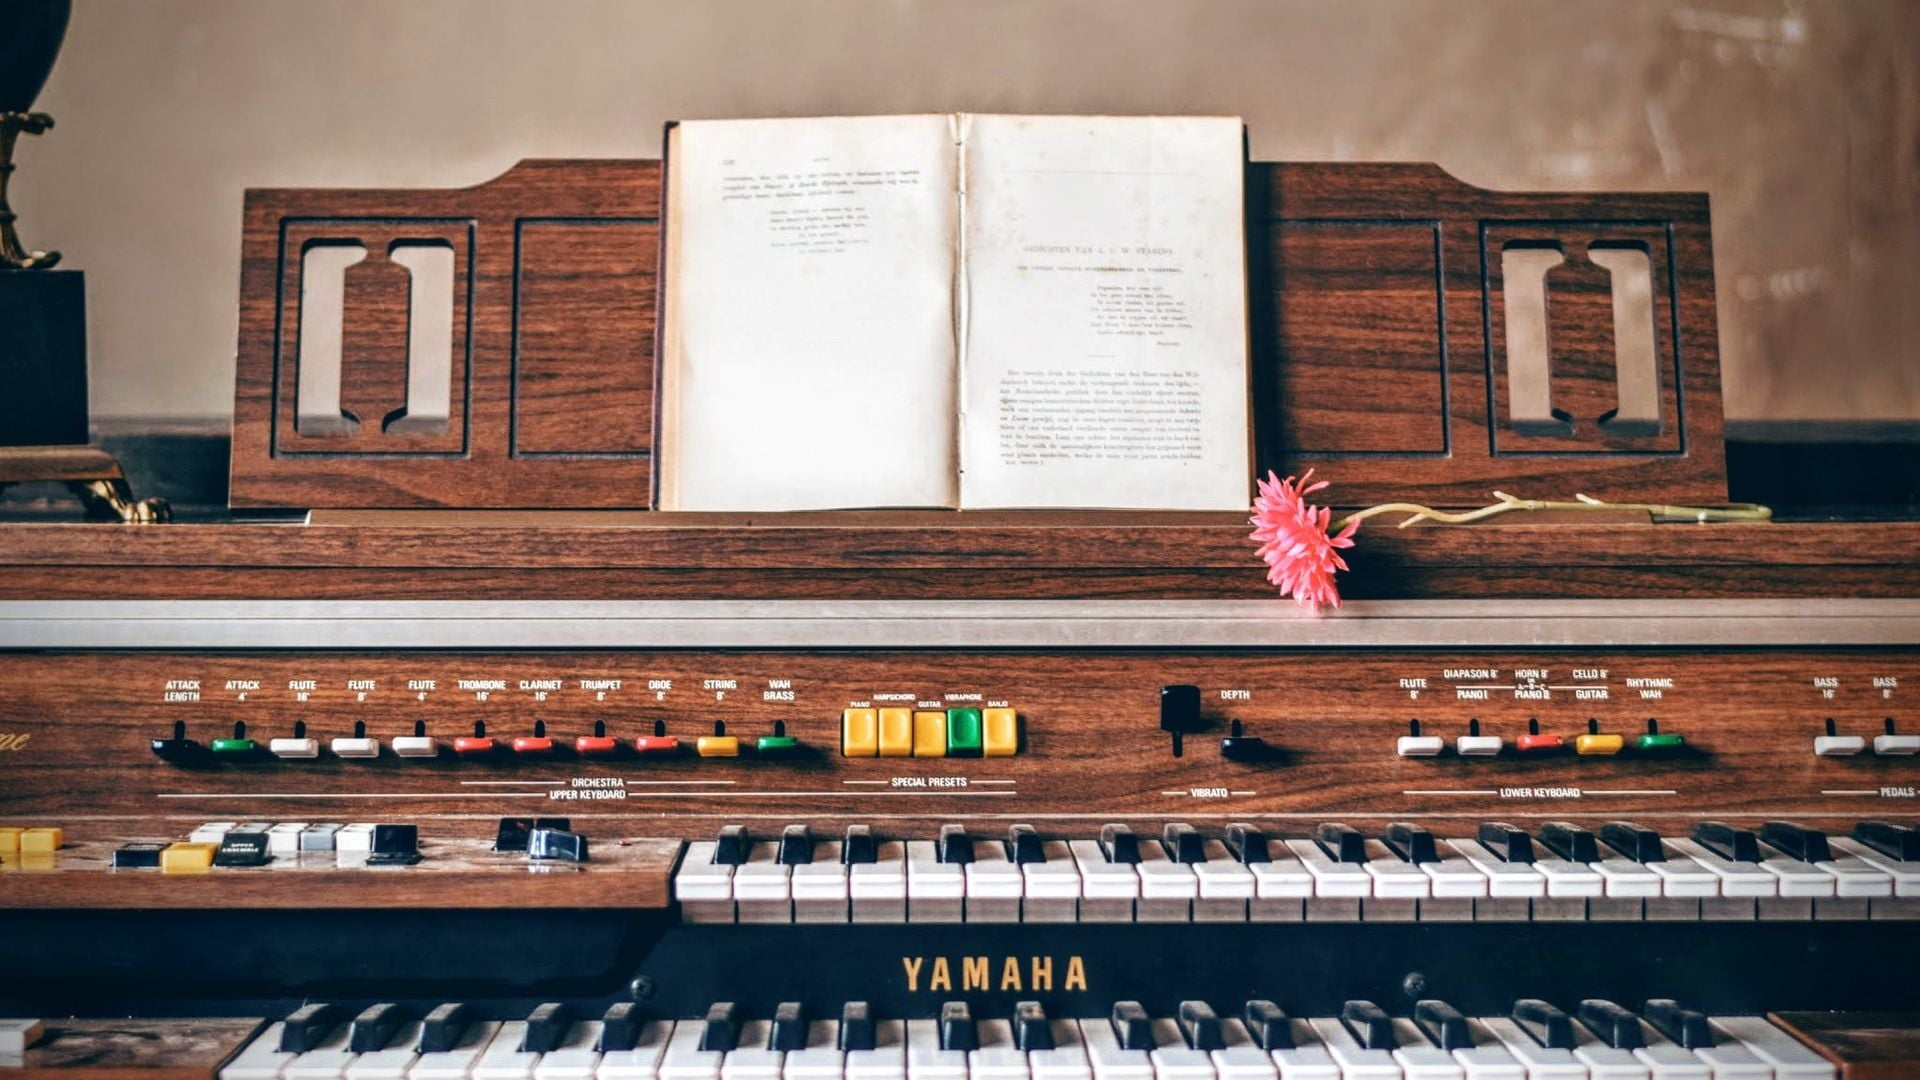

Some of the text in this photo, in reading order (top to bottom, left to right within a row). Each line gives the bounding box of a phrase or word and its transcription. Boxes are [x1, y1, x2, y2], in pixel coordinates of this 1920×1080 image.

[1443, 669, 1489, 679] DIAPASON
[1515, 669, 1539, 678] HORN
[1572, 669, 1598, 679] CELLO
[165, 680, 201, 690] ATTACK
[225, 680, 260, 690] ATTACK
[288, 680, 317, 690] FLUTE
[348, 680, 376, 690] FLUTE
[408, 680, 436, 690] FLUTE
[457, 680, 506, 690] TROMBONE
[519, 680, 563, 690] CLARINET
[579, 680, 622, 690] TRUMPET
[648, 680, 672, 690] OBOE
[703, 680, 738, 690] STRING
[768, 680, 792, 689] WAH
[1399, 678, 1427, 688] FLUTE
[1626, 678, 1673, 688] RHYTHMIC
[1813, 677, 1839, 687] BASS
[1872, 677, 1898, 687] BASS
[164, 691, 200, 702] LENGTH
[763, 691, 795, 701] BRASS
[1220, 690, 1250, 700] DEPTH
[1456, 689, 1483, 700] PIANO
[1514, 689, 1542, 700] PIANO
[1575, 689, 1609, 700] GUITAR
[1639, 689, 1662, 699] WAH
[918, 700, 941, 708] GUITAR
[571, 777, 625, 788] ORCHESTRA
[891, 776, 968, 787] SPECIAL PRESETS
[549, 789, 626, 800] UPPER KEYBOARD
[1190, 787, 1229, 798] VIBRATO
[1500, 787, 1581, 798] LOWER KEYBOARD
[1880, 786, 1916, 798] PEDALS
[902, 956, 1088, 992] YAMAHA
